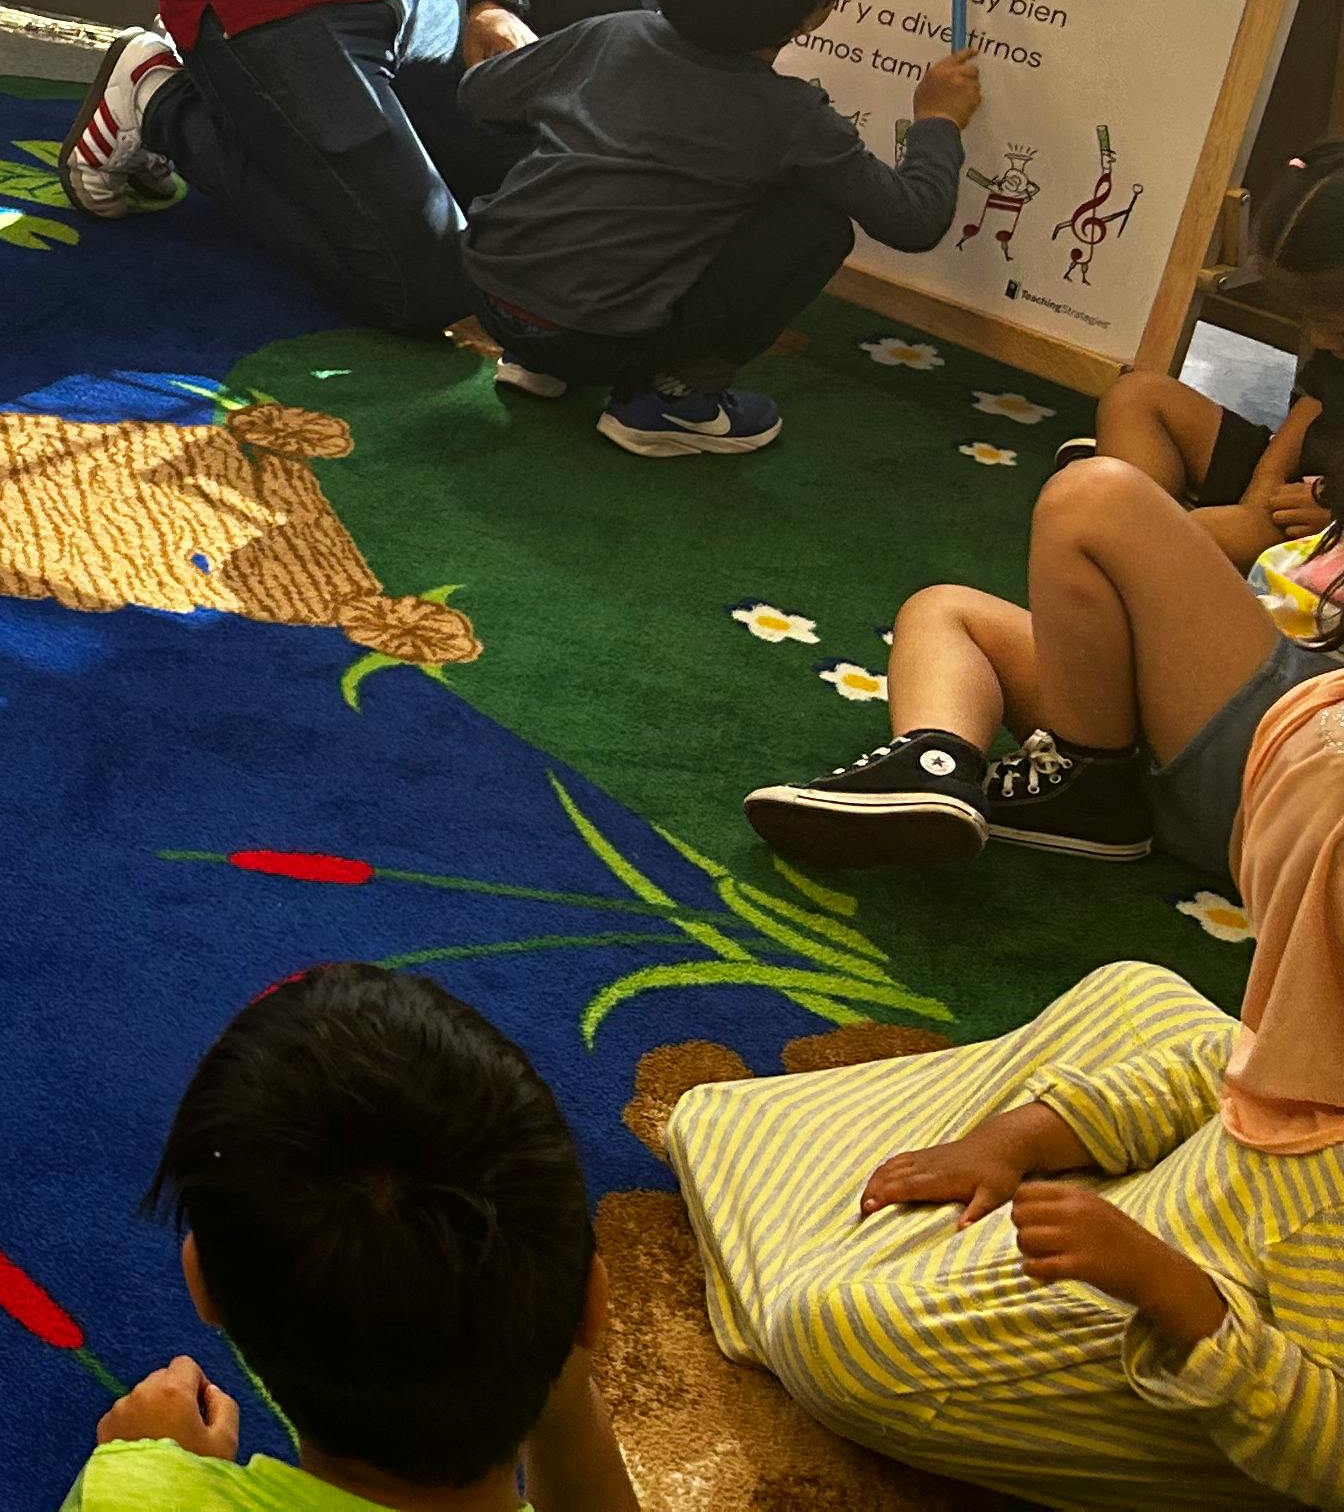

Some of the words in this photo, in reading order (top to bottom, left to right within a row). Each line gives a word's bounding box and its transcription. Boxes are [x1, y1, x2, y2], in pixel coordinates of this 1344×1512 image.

[857, 1, 873, 25] y
[877, 8, 895, 27] a
[901, 12, 1044, 69] divetirnos
